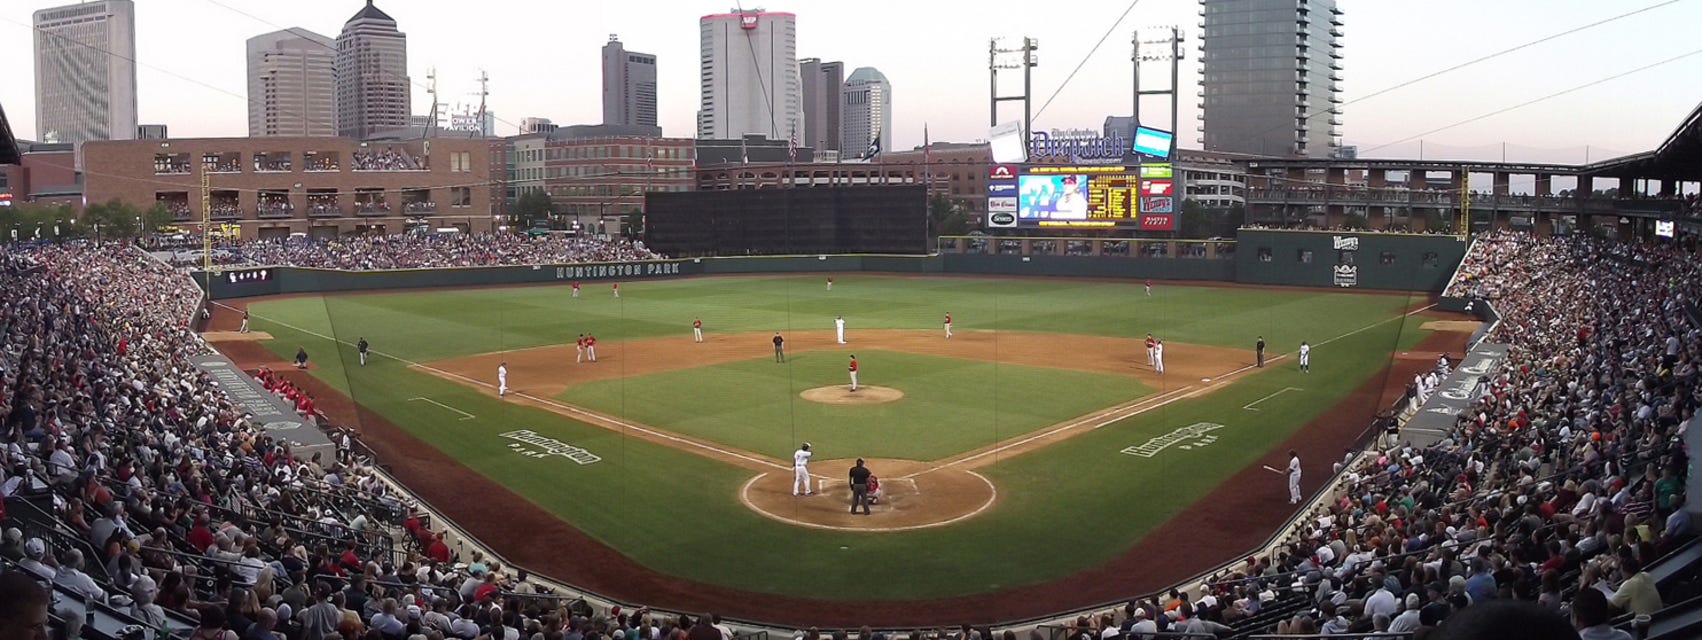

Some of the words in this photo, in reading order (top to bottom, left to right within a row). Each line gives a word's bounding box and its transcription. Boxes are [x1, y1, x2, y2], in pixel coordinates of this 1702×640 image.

[443, 124, 481, 132] PAVILION
[1031, 129, 1125, 163] Dispatch
[556, 264, 642, 278] HUNTINGTON
[647, 262, 680, 274] PARK
[507, 443, 551, 458] PARK
[1178, 433, 1219, 452] PARK
